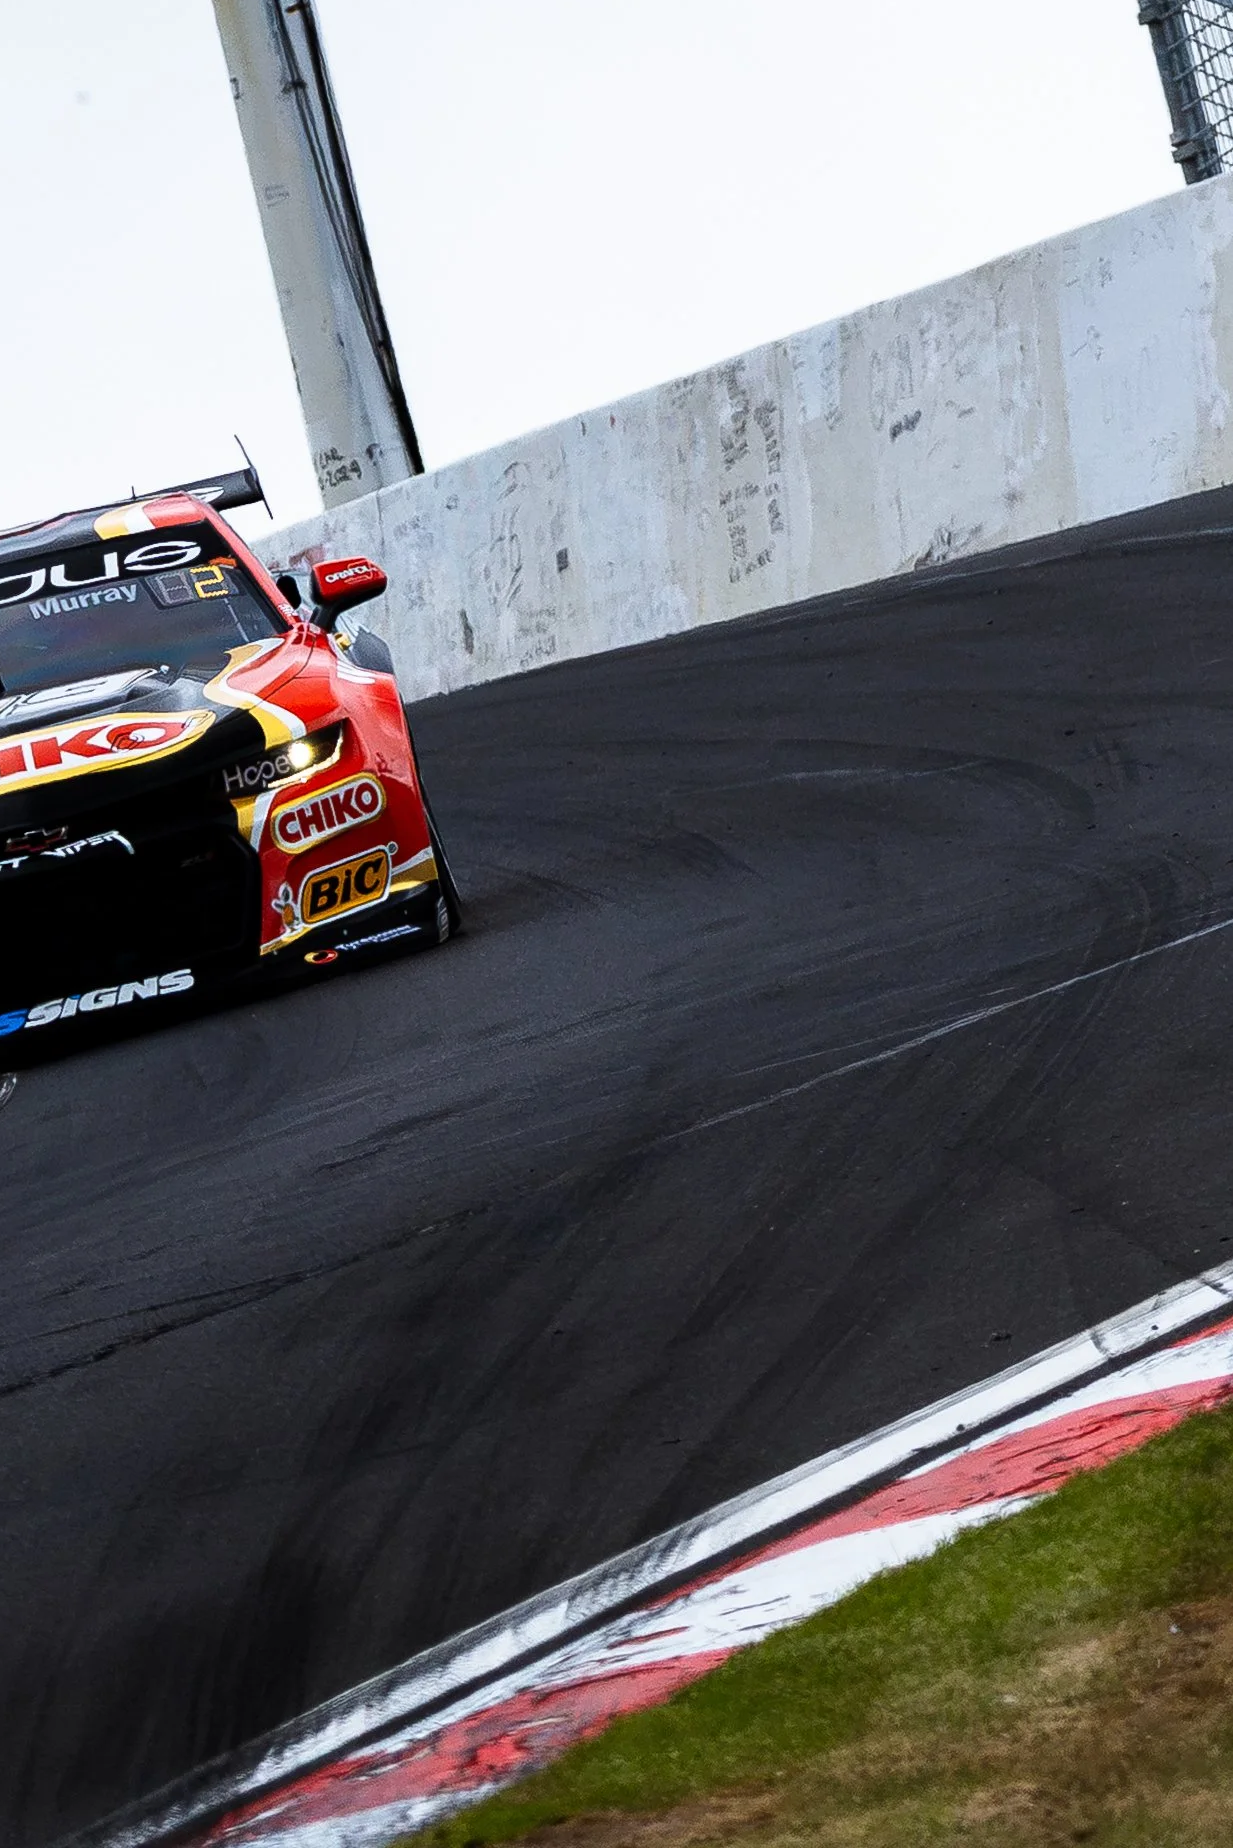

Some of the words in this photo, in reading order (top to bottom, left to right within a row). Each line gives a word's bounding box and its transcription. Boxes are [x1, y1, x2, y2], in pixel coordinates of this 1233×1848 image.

[28, 583, 138, 620] Murray
[222, 754, 291, 793] Hope
[278, 782, 380, 844] CHIKO
